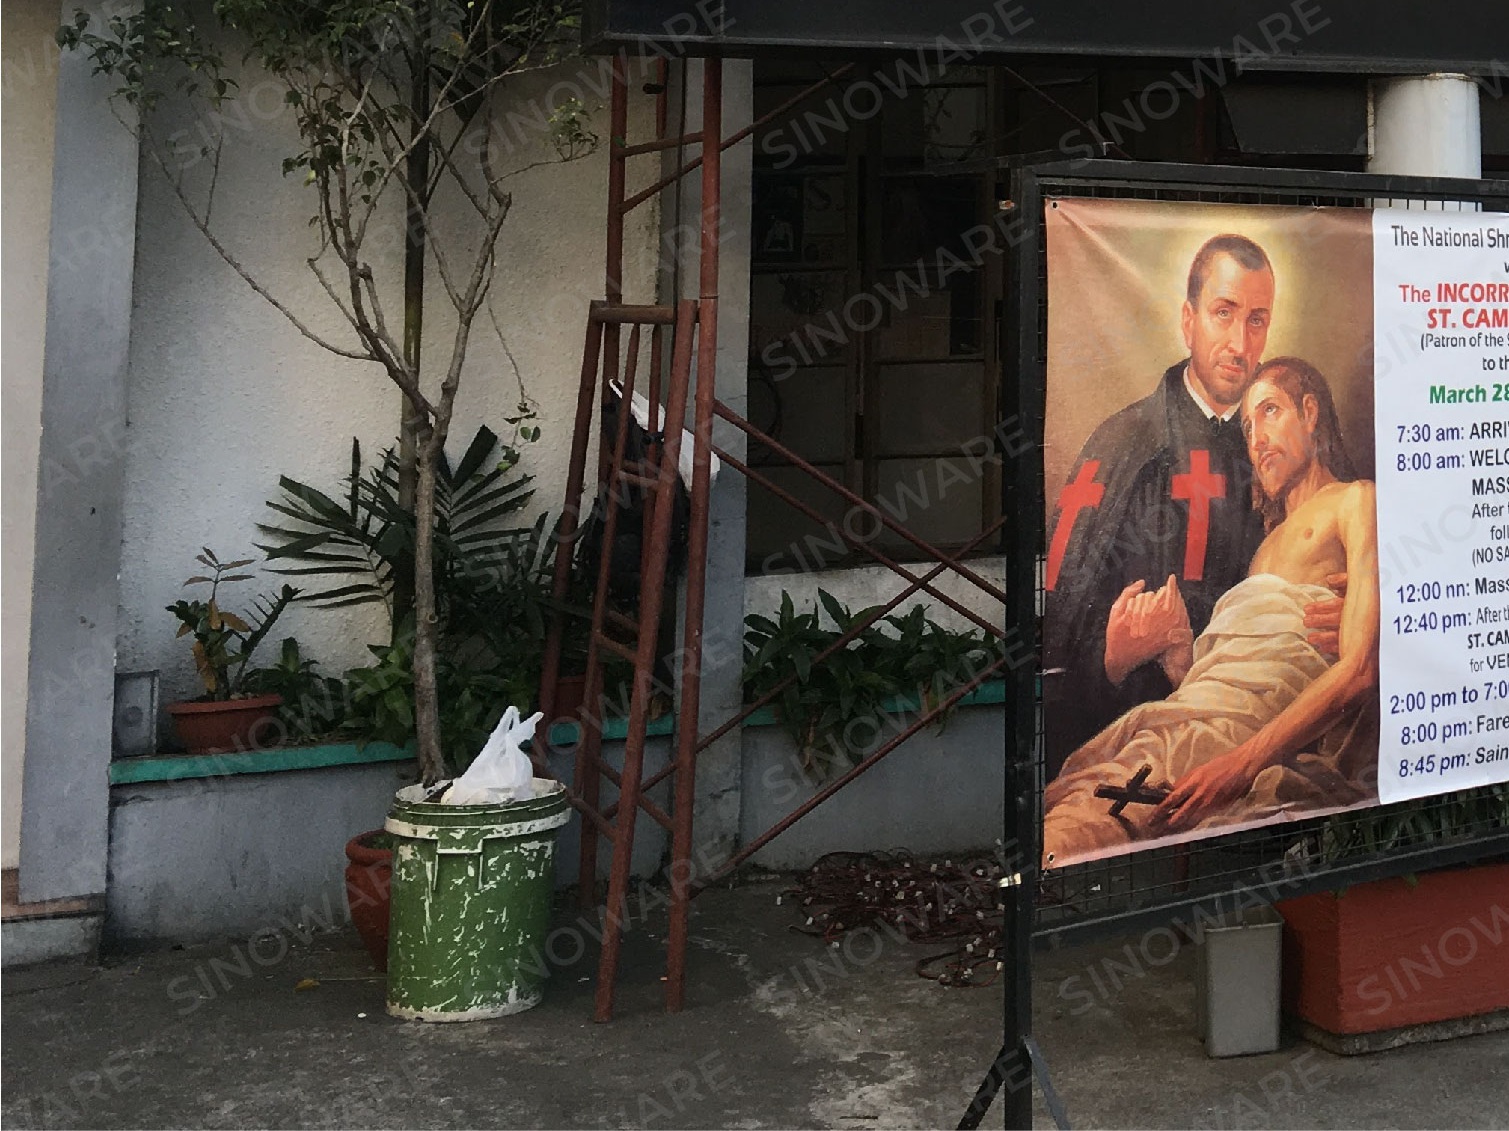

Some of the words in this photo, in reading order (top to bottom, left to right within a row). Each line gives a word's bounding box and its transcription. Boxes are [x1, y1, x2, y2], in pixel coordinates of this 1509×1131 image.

[1391, 225, 1419, 247] The
[1422, 226, 1484, 248] National
[1398, 284, 1431, 303] The
[1427, 308, 1456, 329] ST.
[1468, 332, 1483, 348] of
[1484, 332, 1504, 347] the
[1482, 357, 1496, 371] to
[1429, 384, 1487, 404] March
[1397, 423, 1431, 443] 7:30
[1435, 426, 1464, 442] am:
[1397, 452, 1432, 472] 8:00
[1436, 454, 1465, 470] am:
[1471, 502, 1505, 519] After
[1472, 546, 1494, 568] (NO
[1396, 581, 1441, 604] 12:00
[1446, 582, 1470, 599] nn:
[1476, 606, 1502, 625] After
[1469, 658, 1485, 673] for
[1431, 691, 1457, 713] pm
[1461, 685, 1479, 704] to
[1400, 721, 1437, 746] 8:00
[1442, 720, 1472, 744] pm:
[1398, 754, 1436, 778] 8:45
[1439, 752, 1471, 776] pm:
